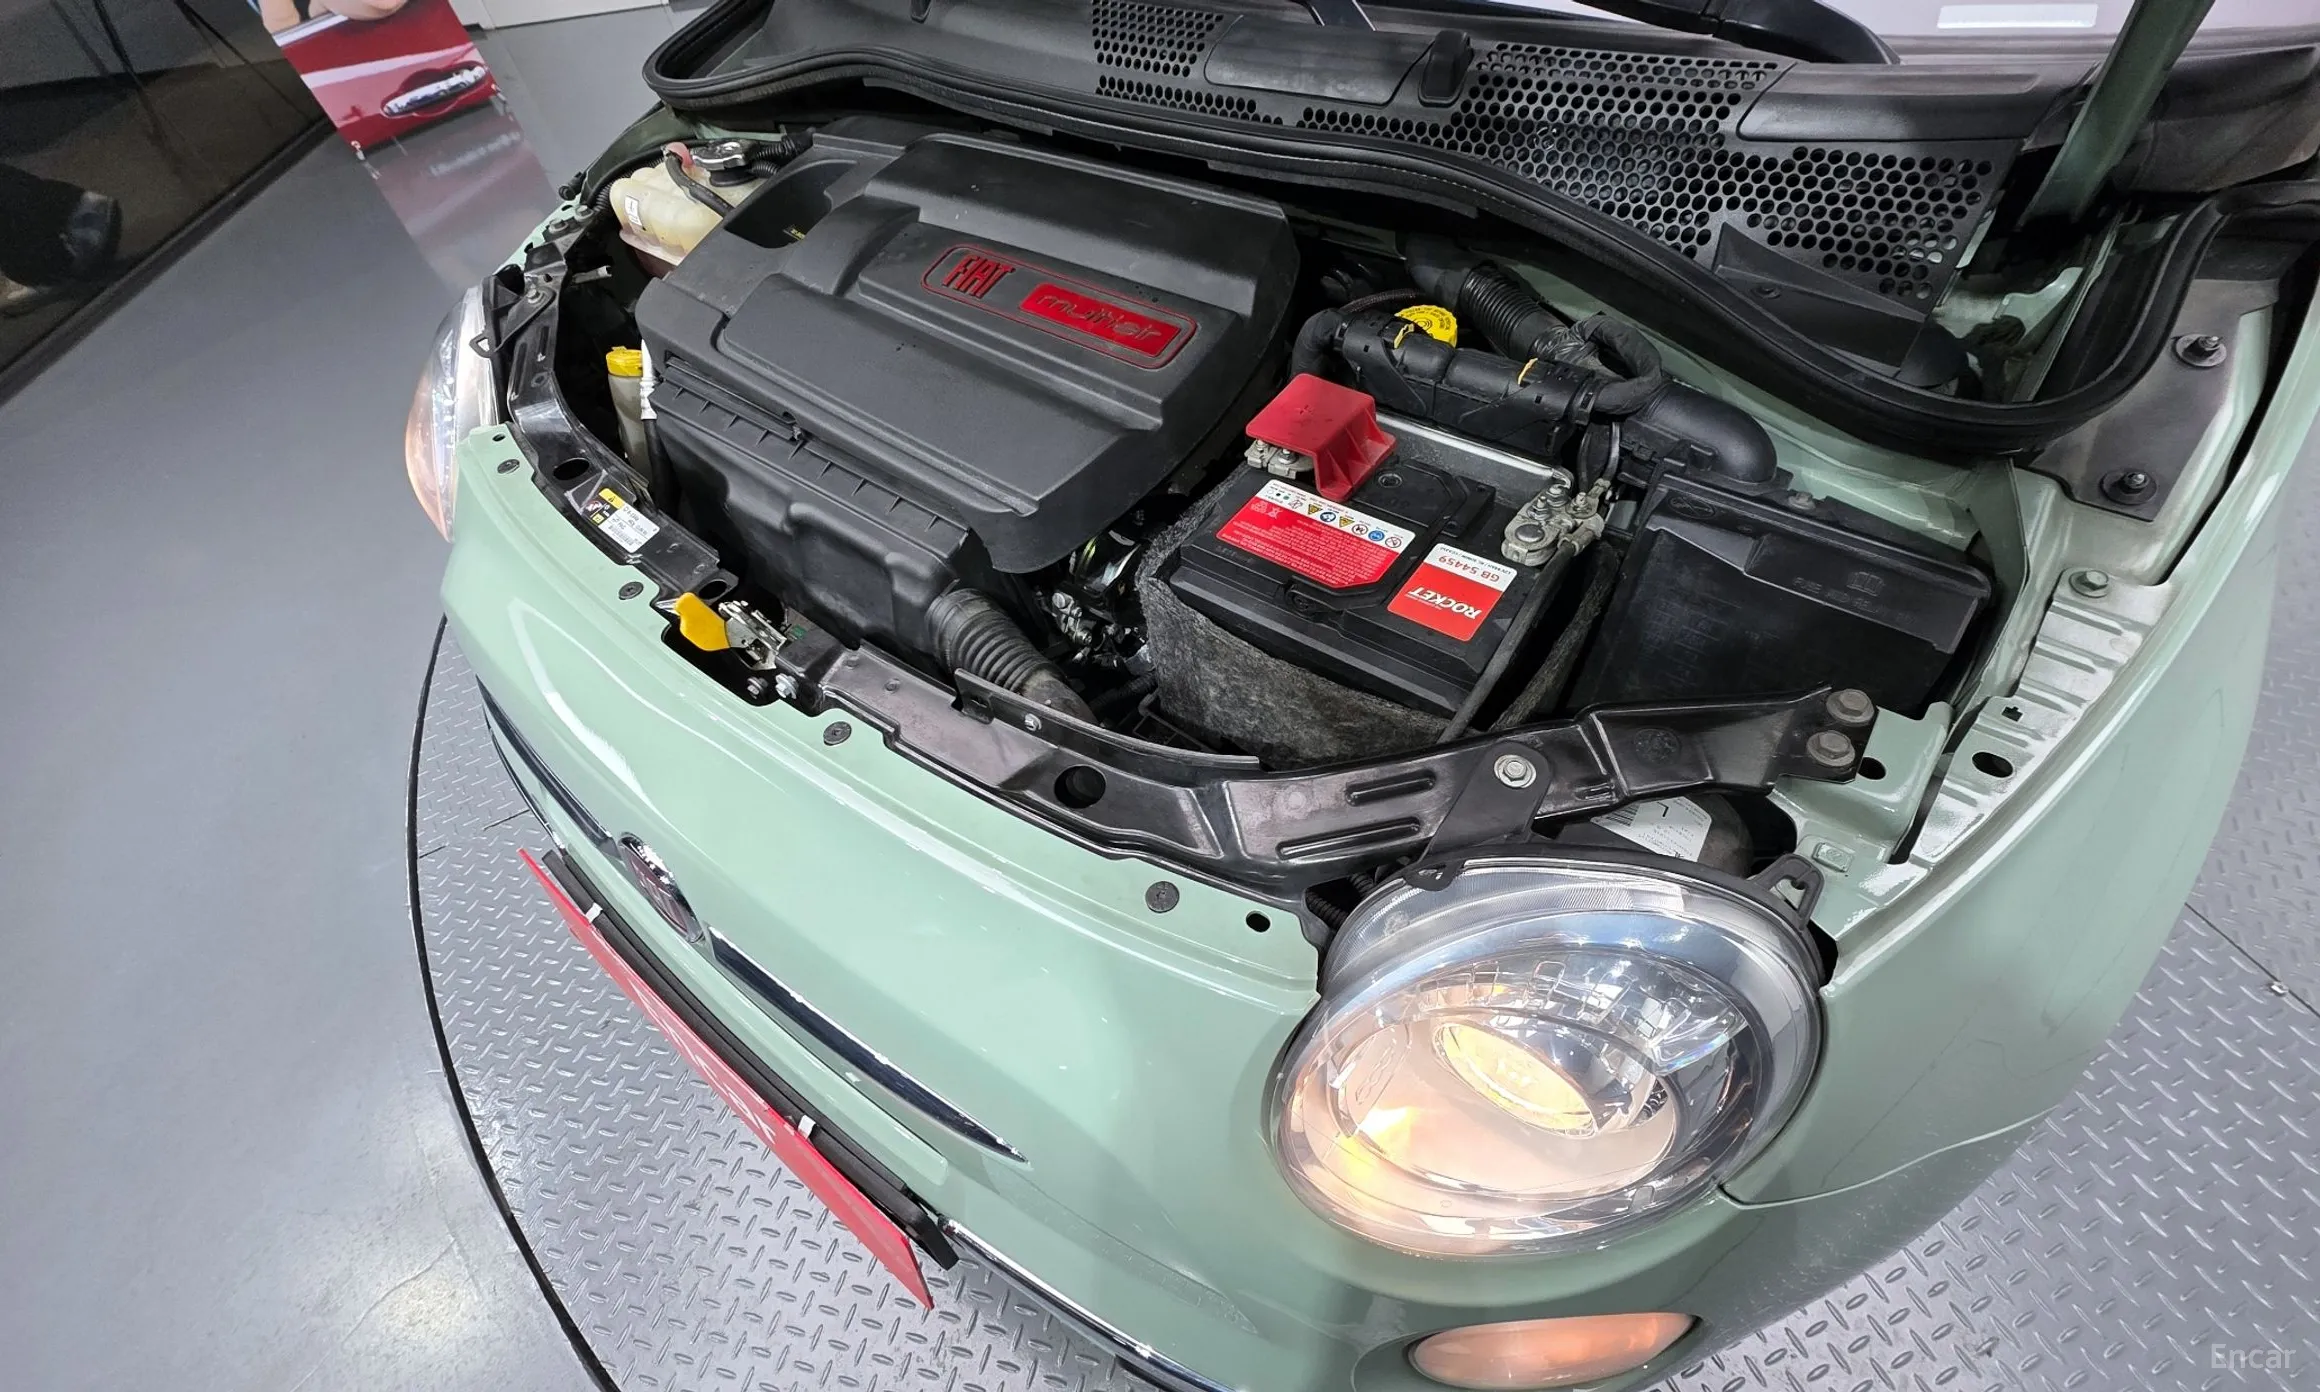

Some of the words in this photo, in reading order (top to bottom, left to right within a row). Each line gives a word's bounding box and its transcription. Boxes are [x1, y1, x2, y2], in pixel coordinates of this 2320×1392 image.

[941, 255, 1016, 299] FIAT
[1438, 555, 1480, 575] 54459
[1480, 571, 1500, 582] GB
[1407, 587, 1483, 619] ROCKET
